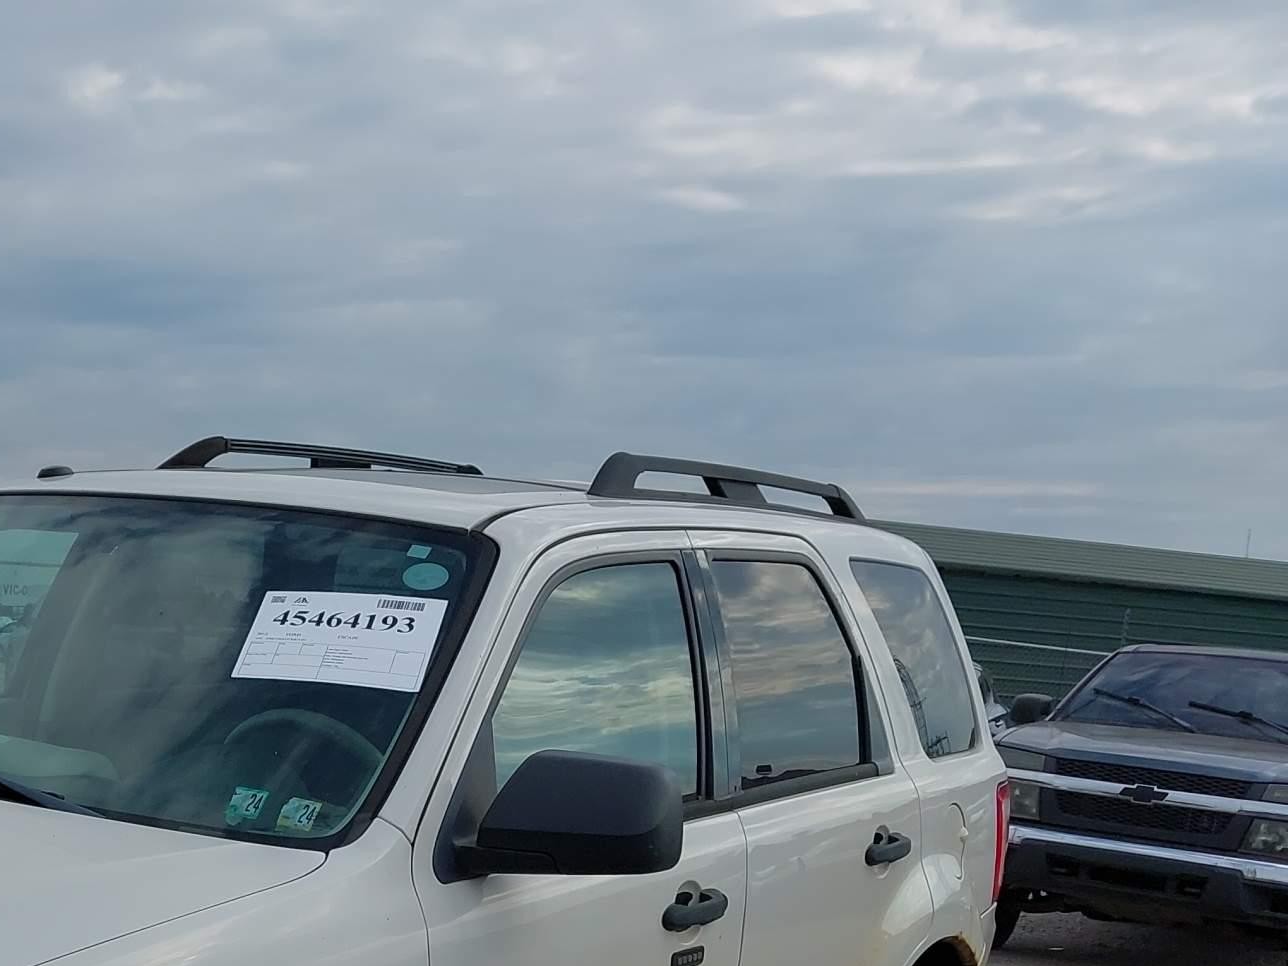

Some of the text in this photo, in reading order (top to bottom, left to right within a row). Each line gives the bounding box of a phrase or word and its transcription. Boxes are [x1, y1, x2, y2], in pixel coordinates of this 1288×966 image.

[273, 609, 416, 634] 45464193
[245, 793, 264, 814] 24
[297, 804, 316, 825] 24
